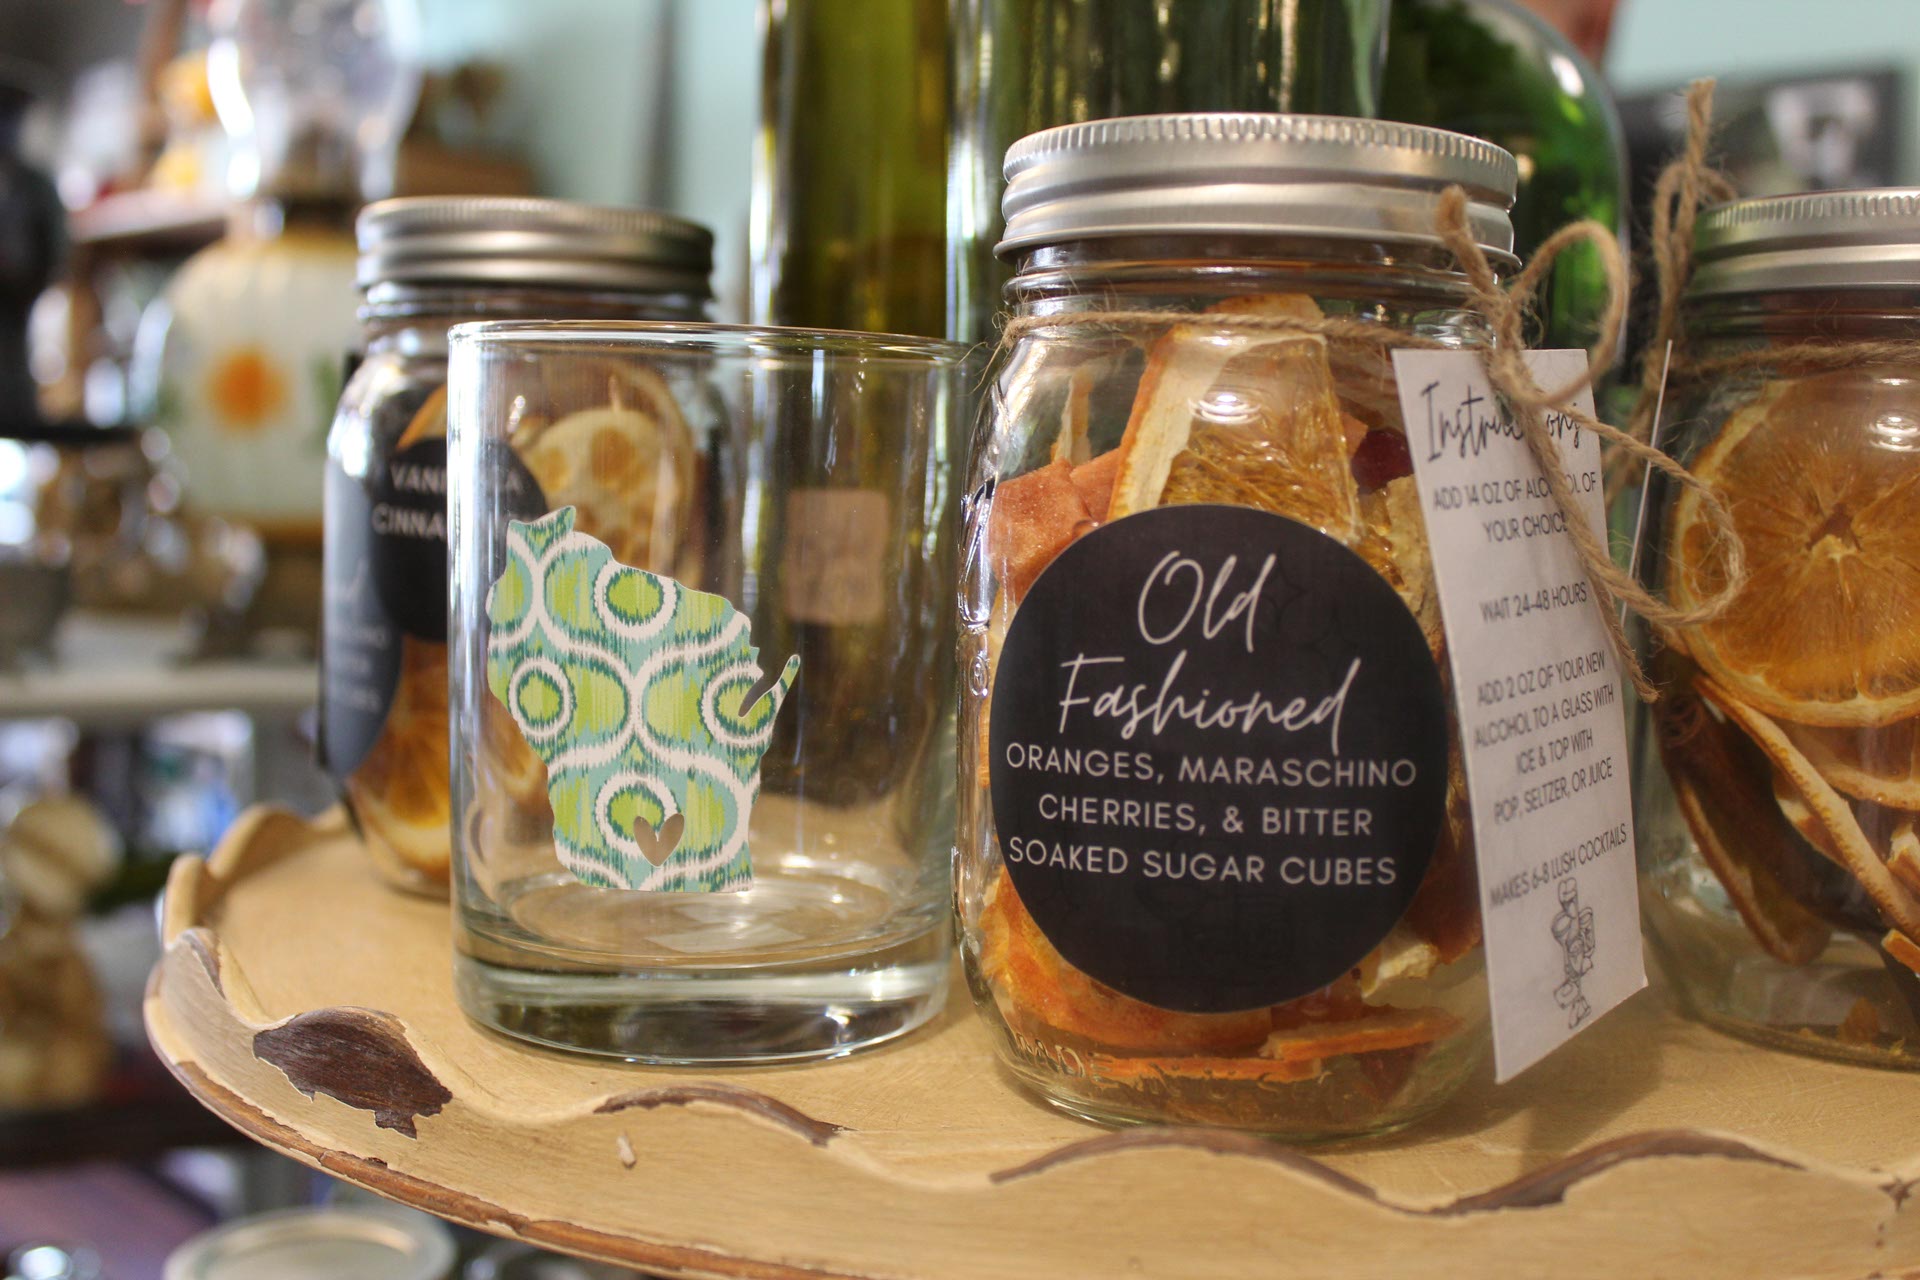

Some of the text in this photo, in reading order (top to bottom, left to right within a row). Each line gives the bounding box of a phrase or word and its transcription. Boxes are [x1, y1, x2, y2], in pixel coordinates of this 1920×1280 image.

[1433, 486, 1463, 513] ADD
[1464, 484, 1480, 507] 14
[1481, 481, 1502, 505] OZ
[1504, 479, 1522, 502] OF
[1582, 471, 1596, 493] OF
[1482, 517, 1522, 543] YOUR
[1138, 550, 1276, 653] Old
[1480, 581, 1588, 624] WAIT 24-48 HOURS
[1060, 649, 1361, 757] Fashioned
[1477, 650, 1605, 706] ADD 2 OZ OF YOUR NEW
[1473, 683, 1614, 748] ALCOHOL TO A GLASS WITH
[1006, 742, 1417, 788] ORANGES, MARASCHINO
[1516, 728, 1594, 775] ICE & TOP WITH
[1524, 776, 1570, 813] SELTZER,
[1572, 768, 1587, 792] OR
[1588, 756, 1613, 786] JUICE
[1039, 794, 1372, 836] CHERRIES, & BITTER
[1009, 836, 1397, 886] SOAKED SUGAR CUBES
[1489, 823, 1627, 907] MAKES 6-8 LUSH COCKTAILS
